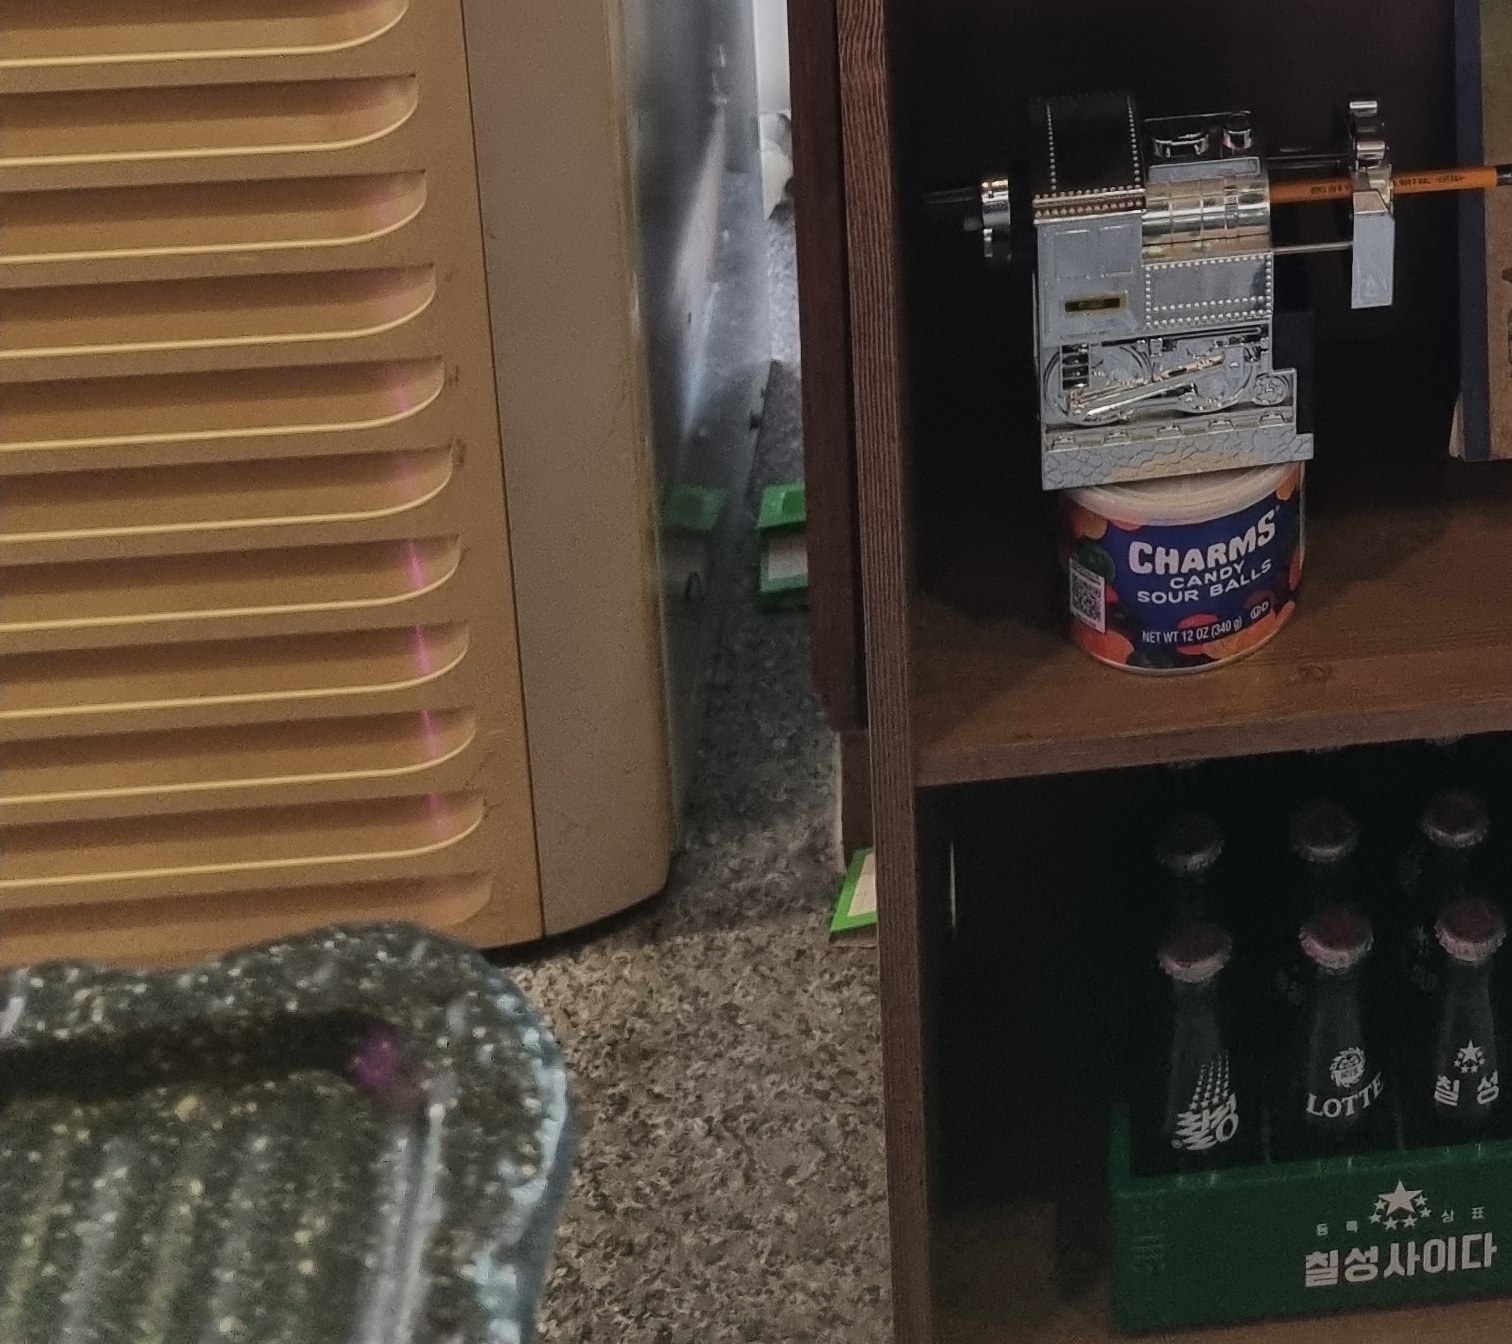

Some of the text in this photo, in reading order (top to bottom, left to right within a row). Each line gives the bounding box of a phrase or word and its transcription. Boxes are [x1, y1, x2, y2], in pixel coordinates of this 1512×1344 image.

[1136, 558, 1273, 605] SOUR BALLS
[1170, 560, 1245, 590] CANDY
[1142, 617, 1243, 644] NET WT 12 OZ (340 g)
[1306, 1070, 1385, 1119] LOTTE
[1305, 1231, 1498, 1288] 칠성사이다
